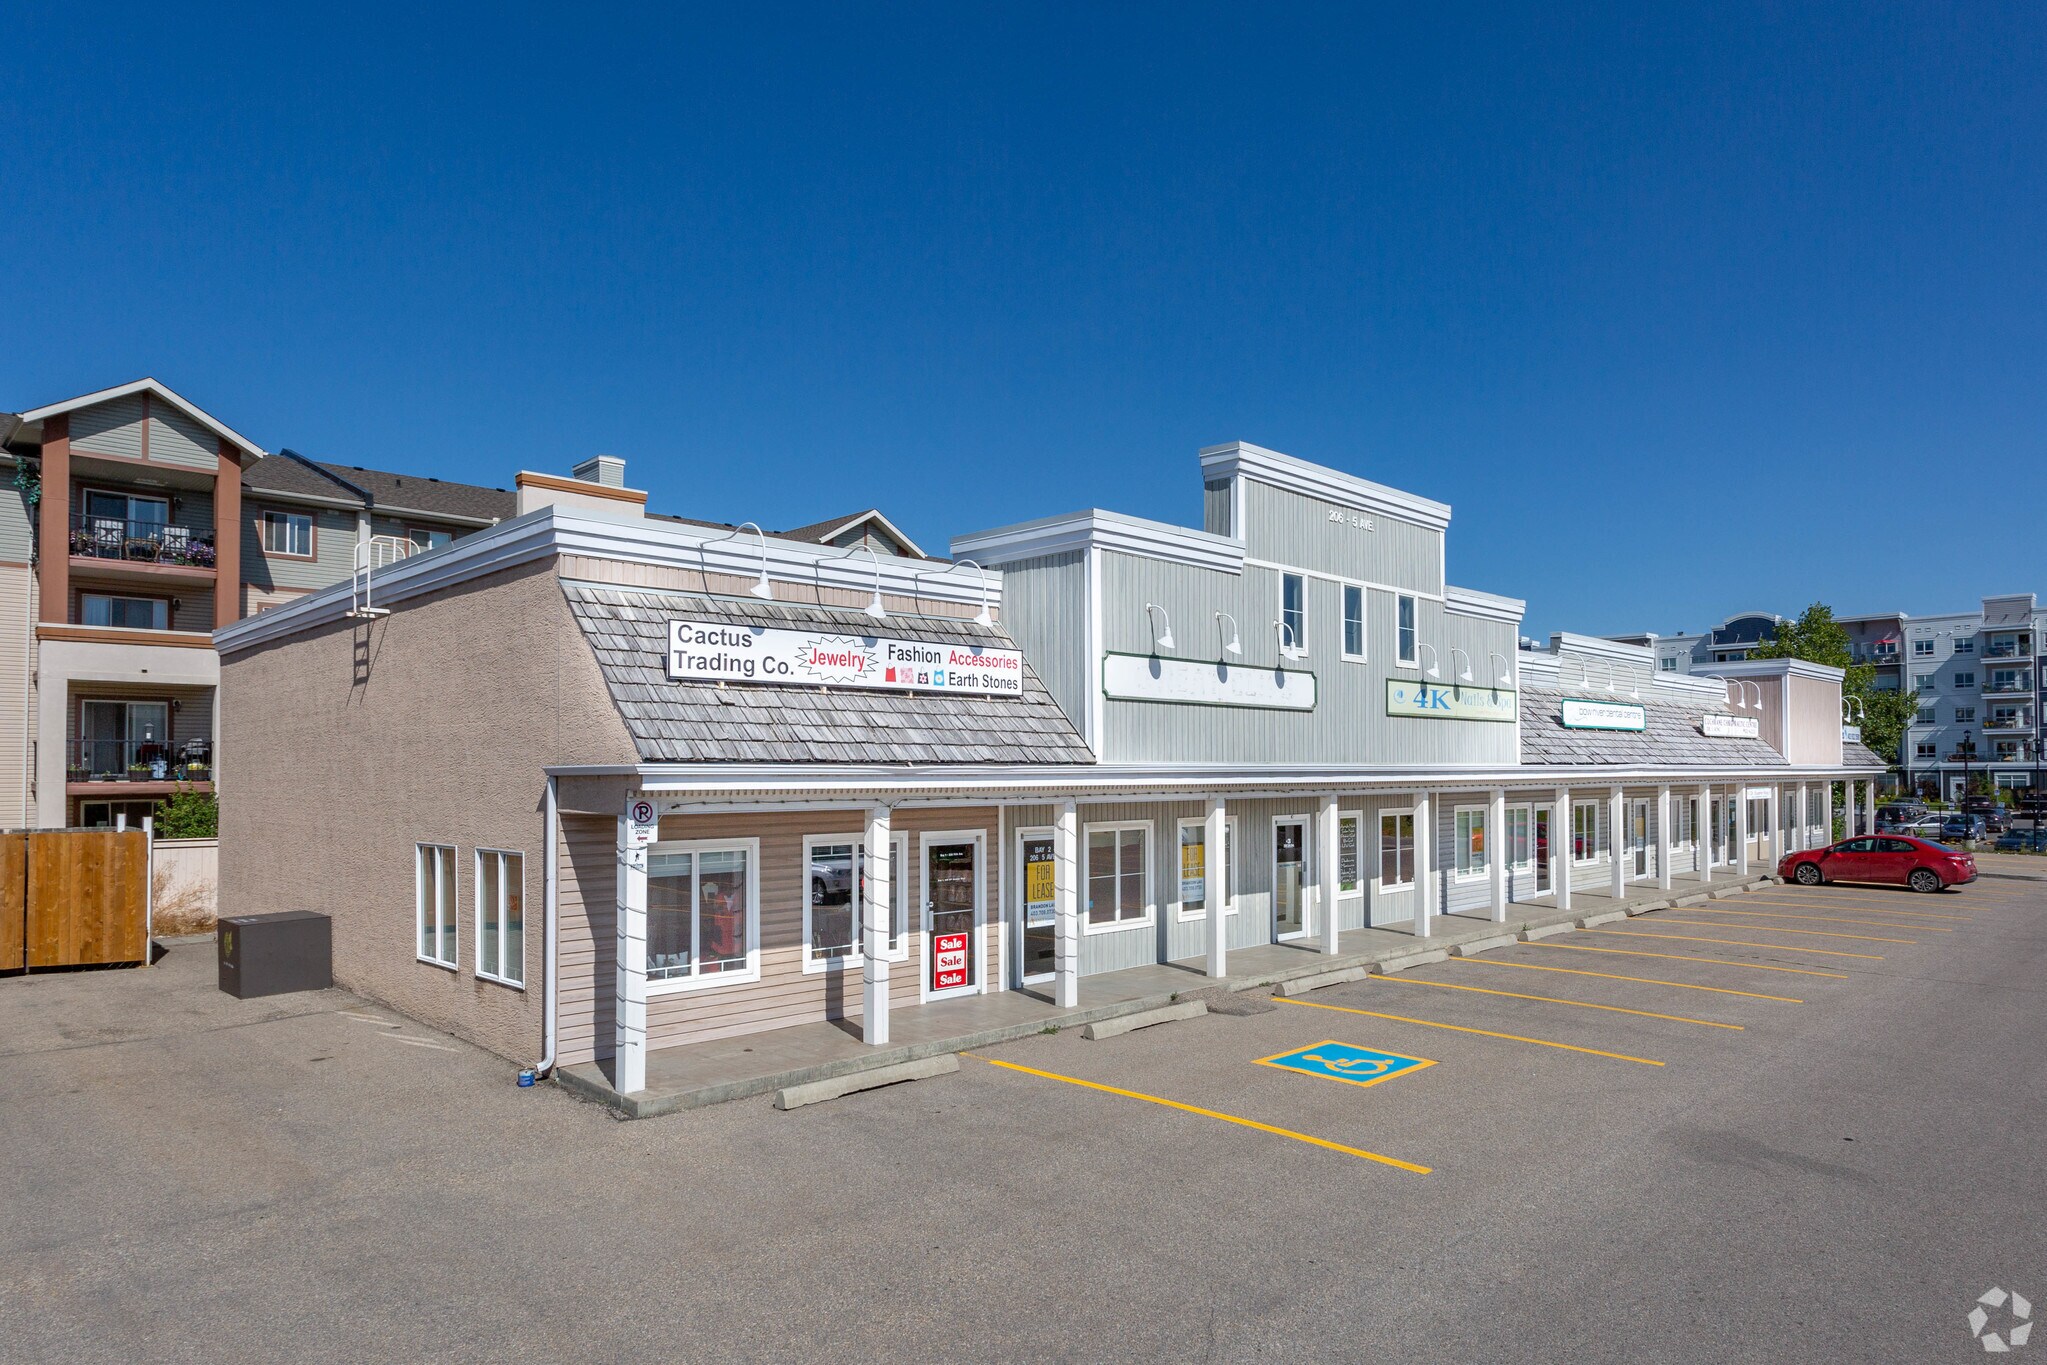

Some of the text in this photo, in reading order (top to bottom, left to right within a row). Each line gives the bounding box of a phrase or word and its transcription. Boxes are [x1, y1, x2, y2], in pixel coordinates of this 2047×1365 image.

[1329, 510, 1343, 524] 206
[1352, 516, 1358, 528] 5
[678, 624, 752, 648] Cactus
[673, 650, 795, 677] Trading Co.
[809, 648, 865, 672] Jewelry
[888, 643, 1018, 670] Fashion Accessories
[949, 671, 1018, 690] Earth Stones
[1413, 689, 1451, 710] 4K
[1461, 691, 1484, 707] Nails
[1186, 847, 1198, 862] FOR
[1036, 865, 1051, 881] FOR
[1032, 882, 1055, 899] LEASE
[940, 938, 962, 950] Sale
[940, 955, 962, 967] Sale
[940, 972, 962, 985] Sale
